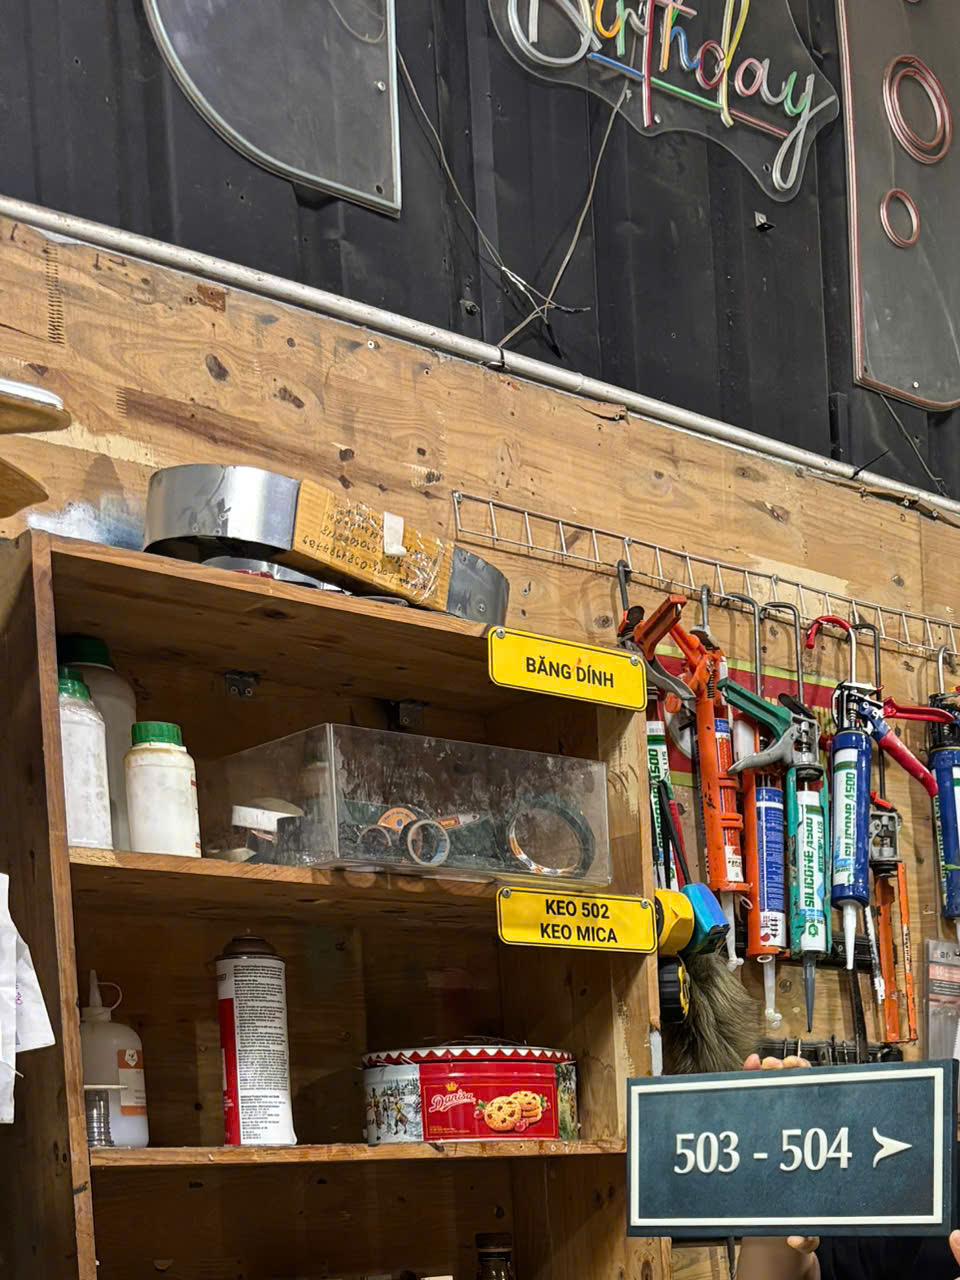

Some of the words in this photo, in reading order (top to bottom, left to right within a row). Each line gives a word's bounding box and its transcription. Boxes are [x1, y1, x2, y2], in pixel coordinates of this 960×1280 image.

[526, 655, 572, 679] BĂNG
[576, 663, 614, 688] DÍNH
[804, 850, 816, 908] SILICONE
[545, 899, 577, 916] KEO
[582, 901, 610, 919] 502
[540, 923, 572, 940] KEO
[577, 926, 618, 943] MICA
[428, 1089, 476, 1113] Danisa
[673, 1131, 740, 1174] 503
[779, 1127, 852, 1171] 504
